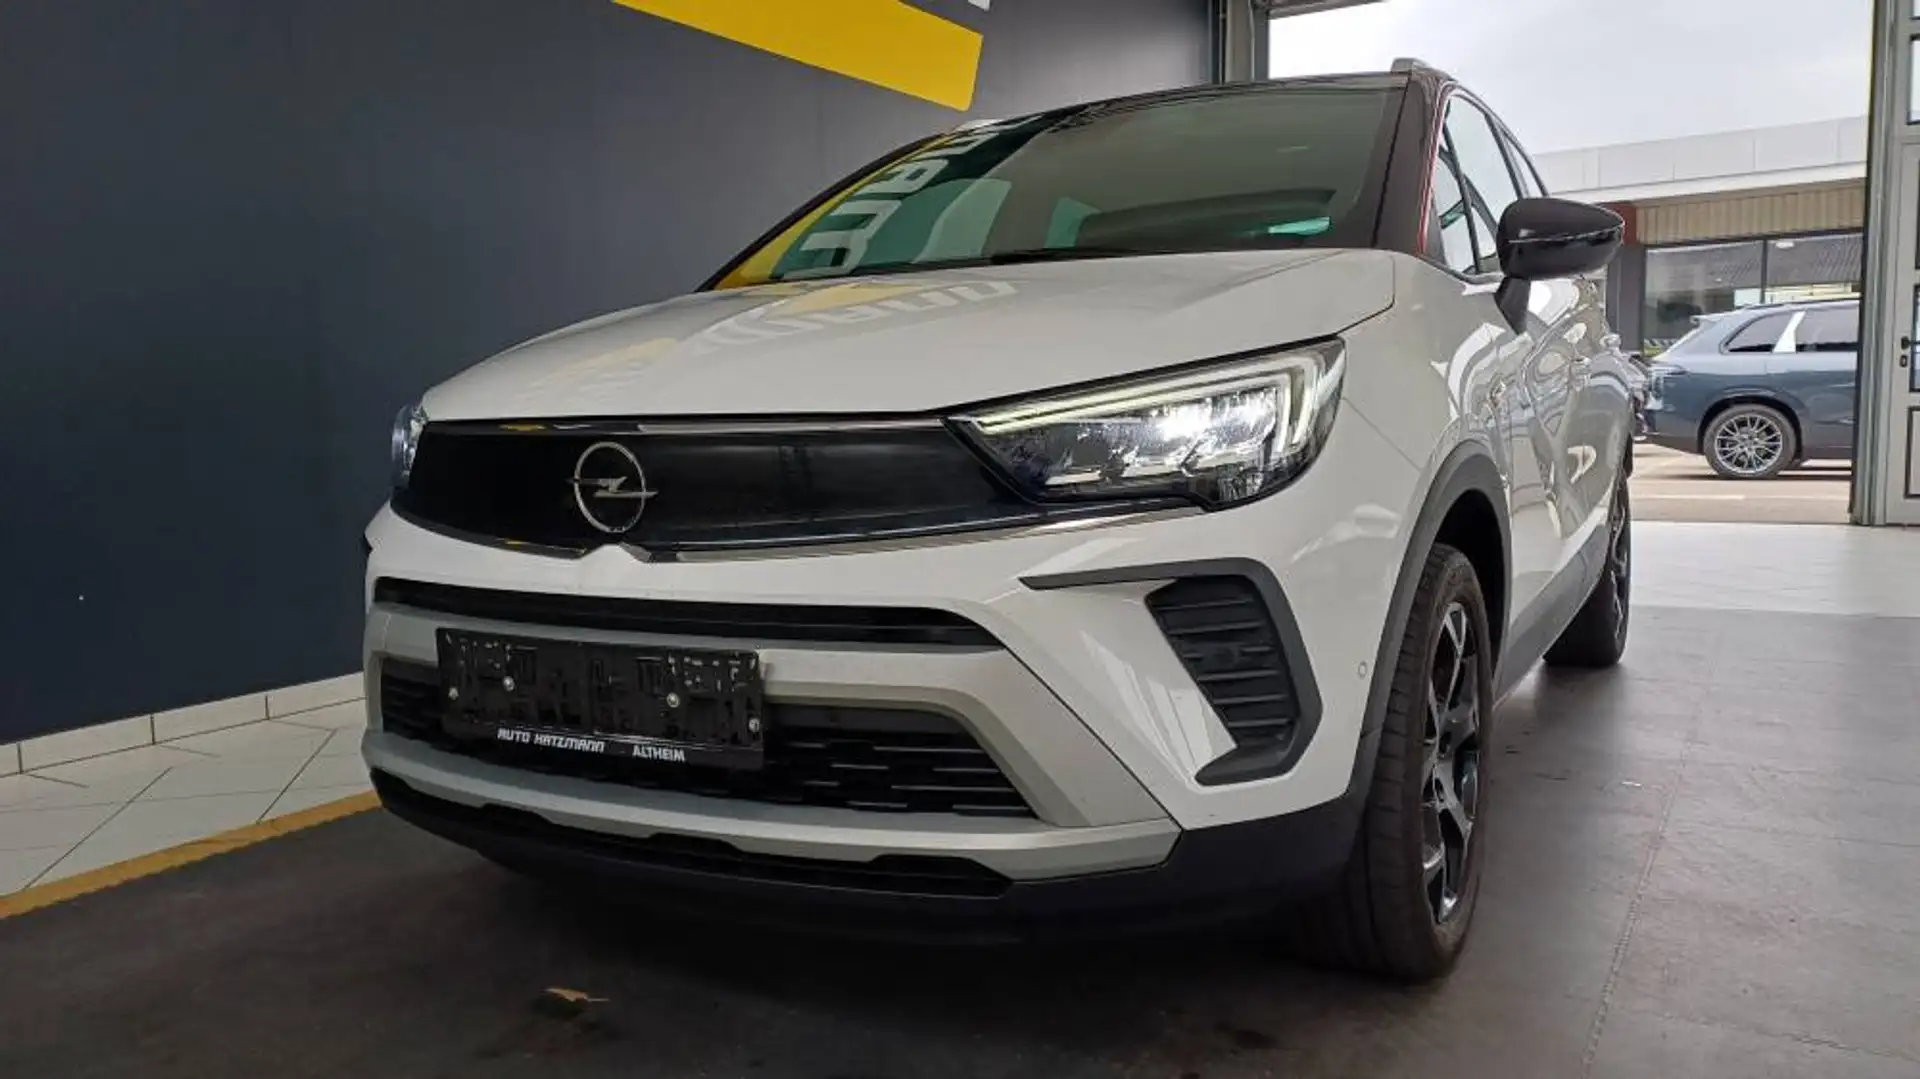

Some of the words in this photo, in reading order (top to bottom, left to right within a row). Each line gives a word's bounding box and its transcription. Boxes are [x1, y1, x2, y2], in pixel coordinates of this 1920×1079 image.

[497, 728, 531, 743] AUTO
[534, 733, 605, 753] HATZMANN
[632, 744, 685, 762] ALTHEIM
